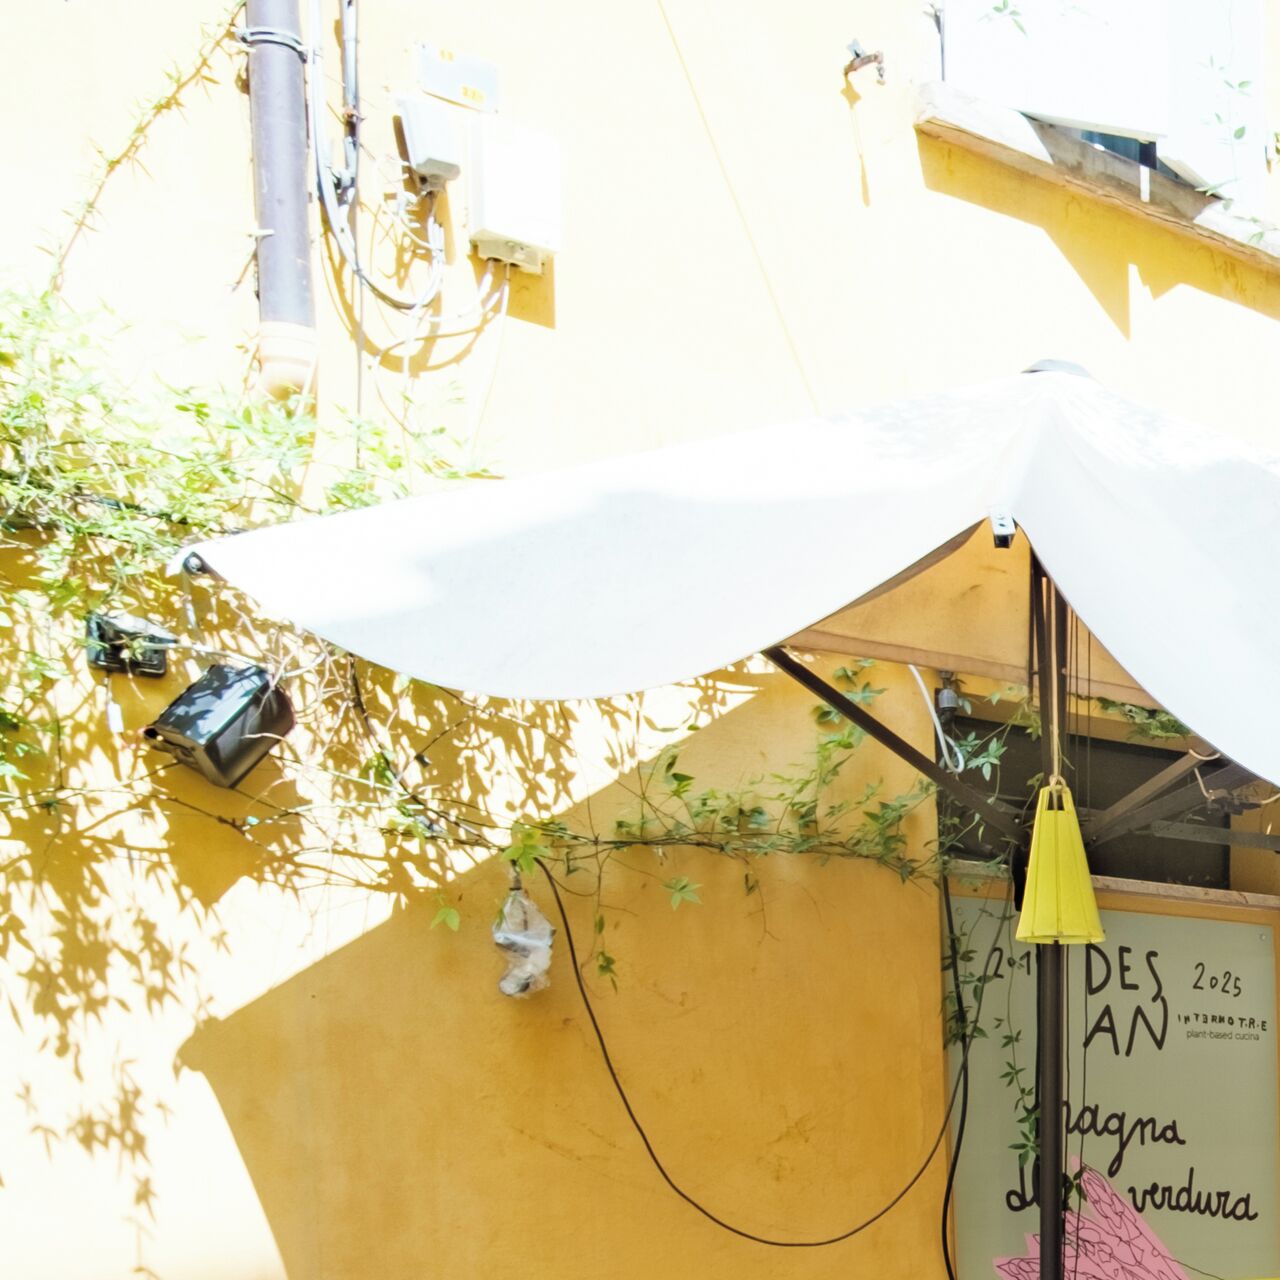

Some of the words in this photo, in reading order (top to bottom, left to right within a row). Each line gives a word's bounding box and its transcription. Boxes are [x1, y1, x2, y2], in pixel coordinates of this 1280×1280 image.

[1085, 943, 1163, 1003] DES
[1192, 962, 1242, 997] 2025
[1083, 996, 1168, 1057] AN
[1235, 1031, 1260, 1041] cucina
[1128, 1166, 1259, 1222] verdura
